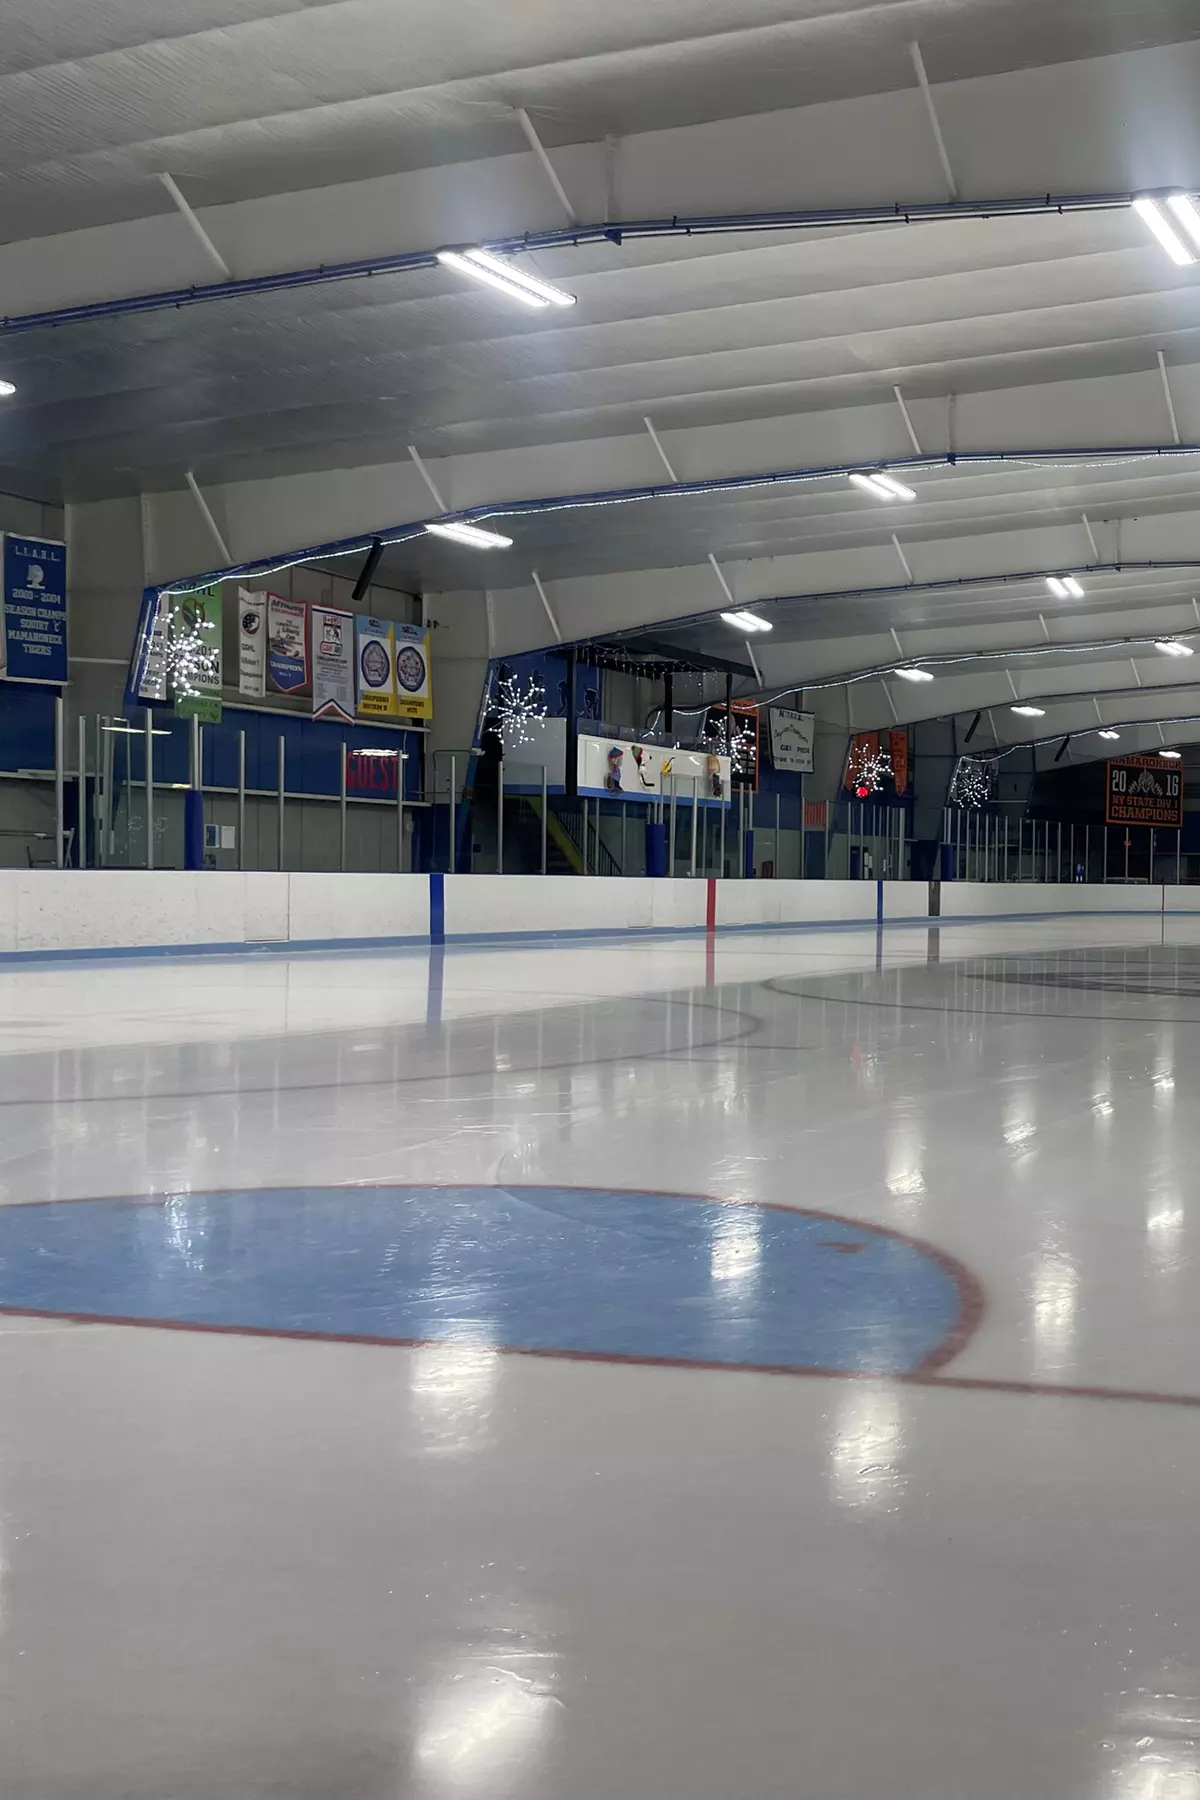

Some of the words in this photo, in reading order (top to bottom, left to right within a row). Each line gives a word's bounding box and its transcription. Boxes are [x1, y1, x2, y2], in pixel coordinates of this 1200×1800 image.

[4, 603, 37, 618] SEASON
[8, 628, 63, 645] MAMARONECK
[22, 643, 52, 656] TIGERS
[346, 752, 399, 791] GUEST
[1112, 770, 1127, 792] 20
[1165, 774, 1179, 796] 16
[1112, 795, 1126, 805] NY
[1127, 796, 1155, 807] STATE
[1111, 806, 1179, 821] CHAMPIONS
